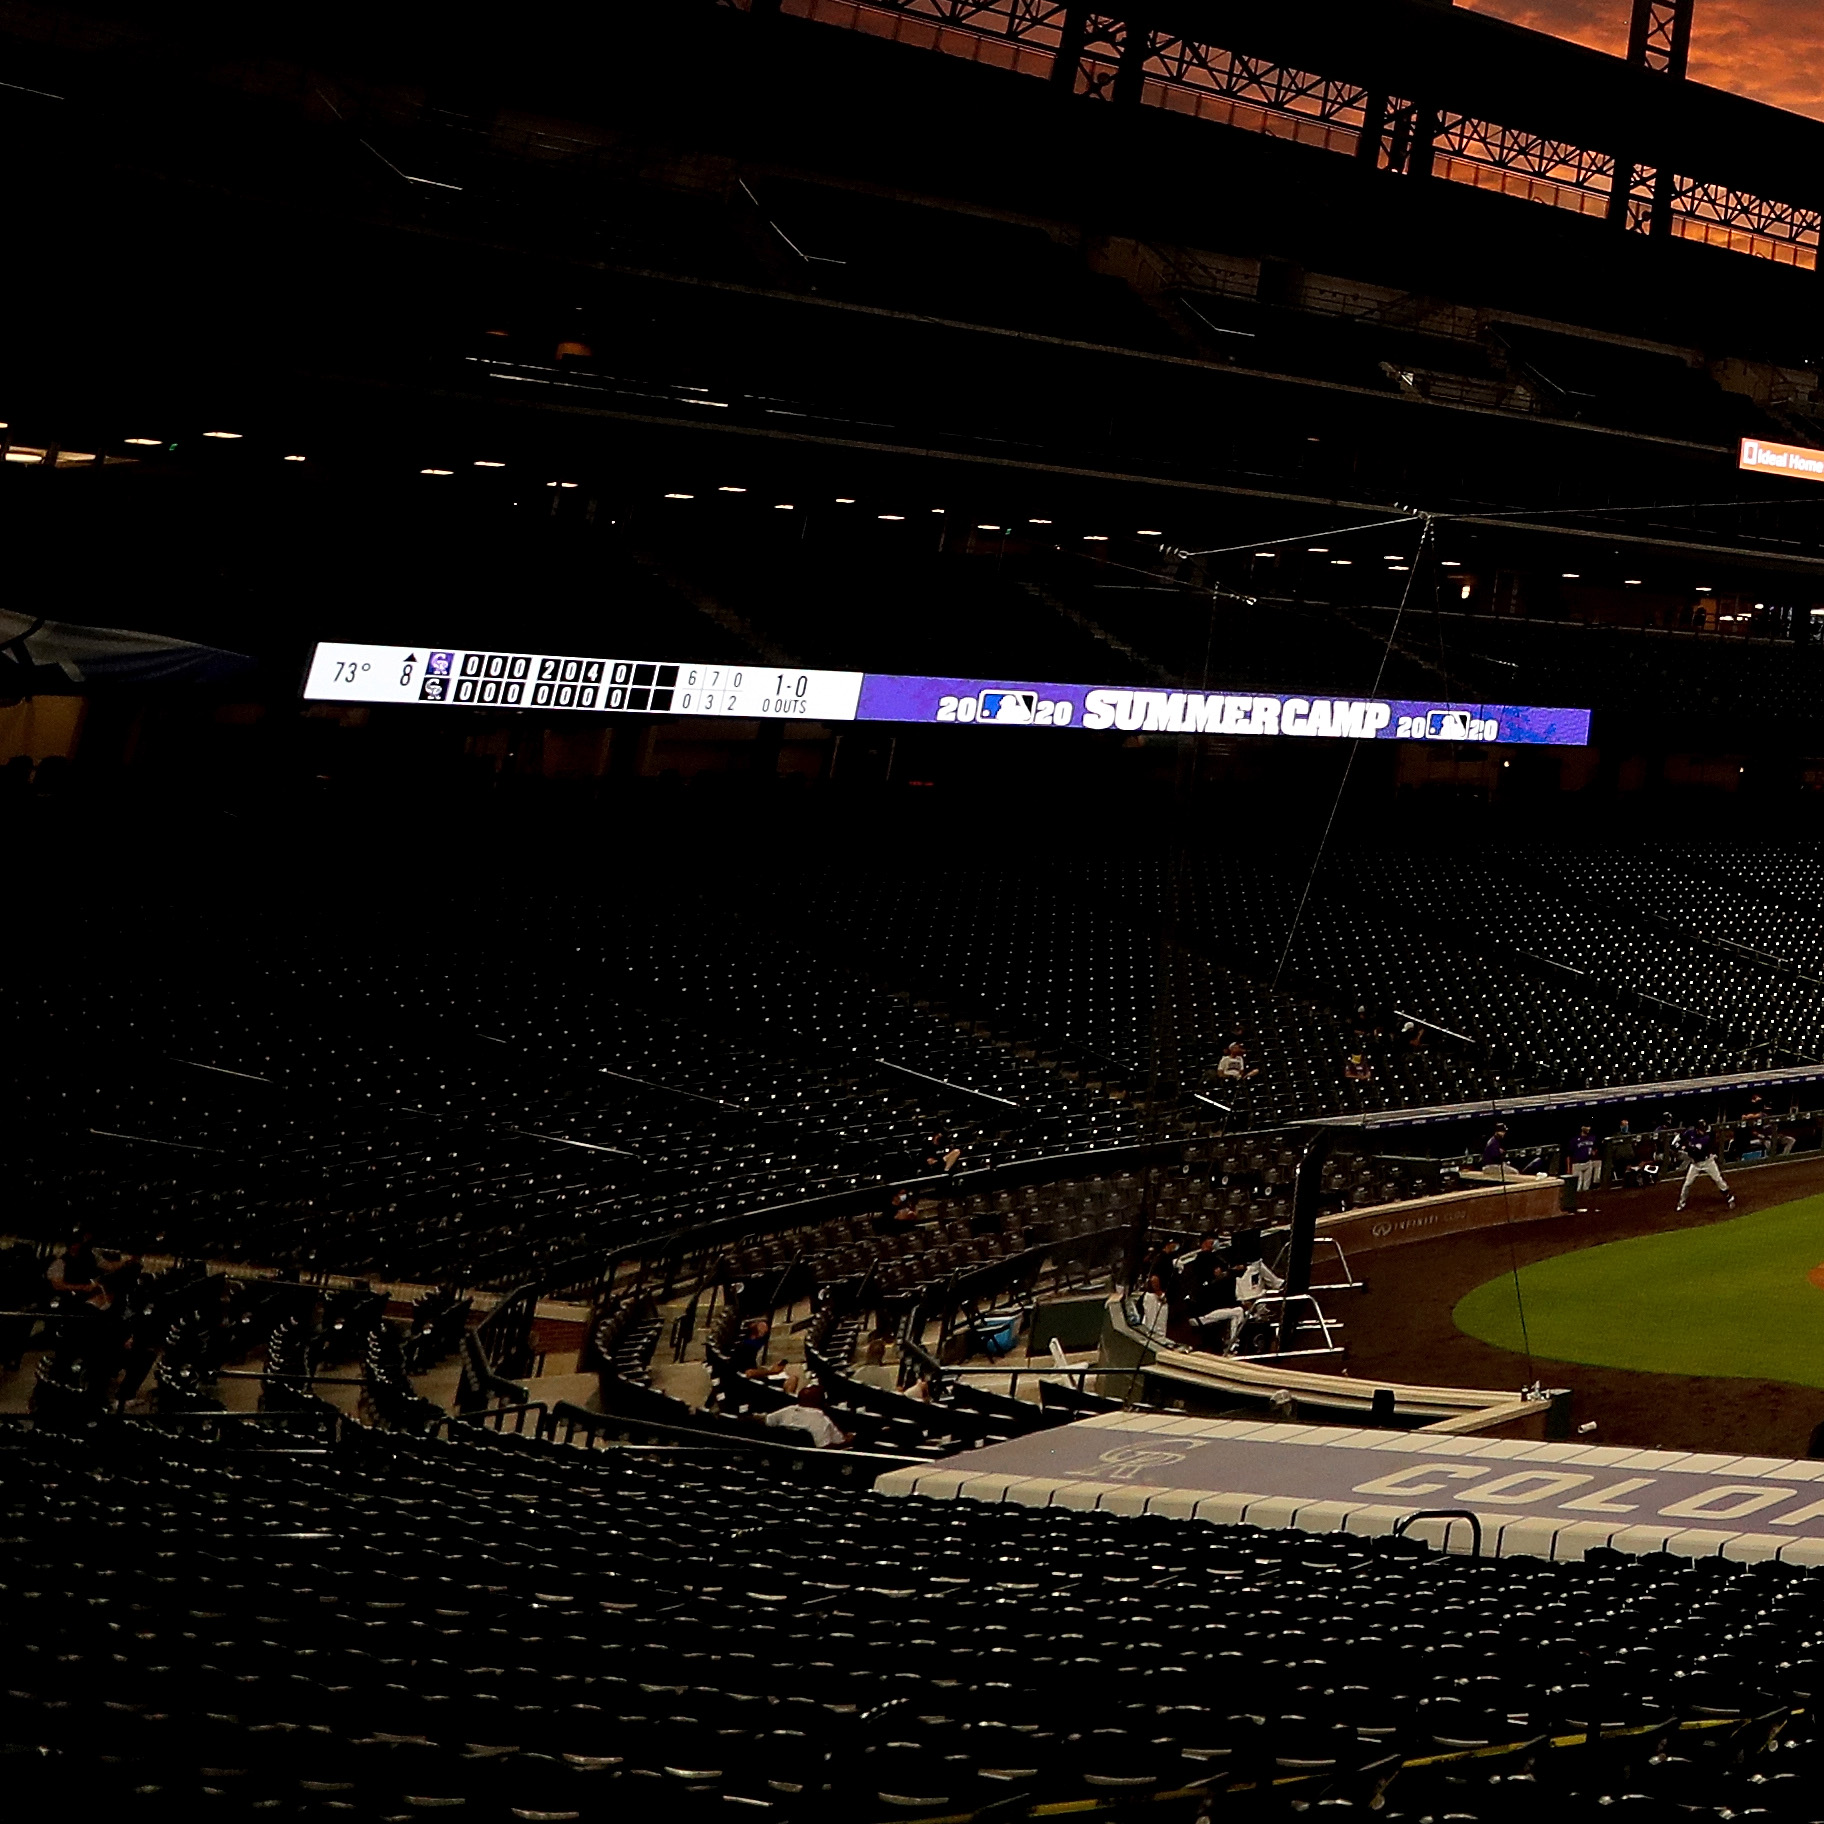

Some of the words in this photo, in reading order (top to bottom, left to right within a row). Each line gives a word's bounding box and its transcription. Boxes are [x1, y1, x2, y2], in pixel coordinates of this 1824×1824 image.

[1758, 449, 1787, 467] Ideal
[1789, 455, 1823, 473] Home
[400, 664, 413, 686] 8
[774, 700, 807, 714] OUTS
